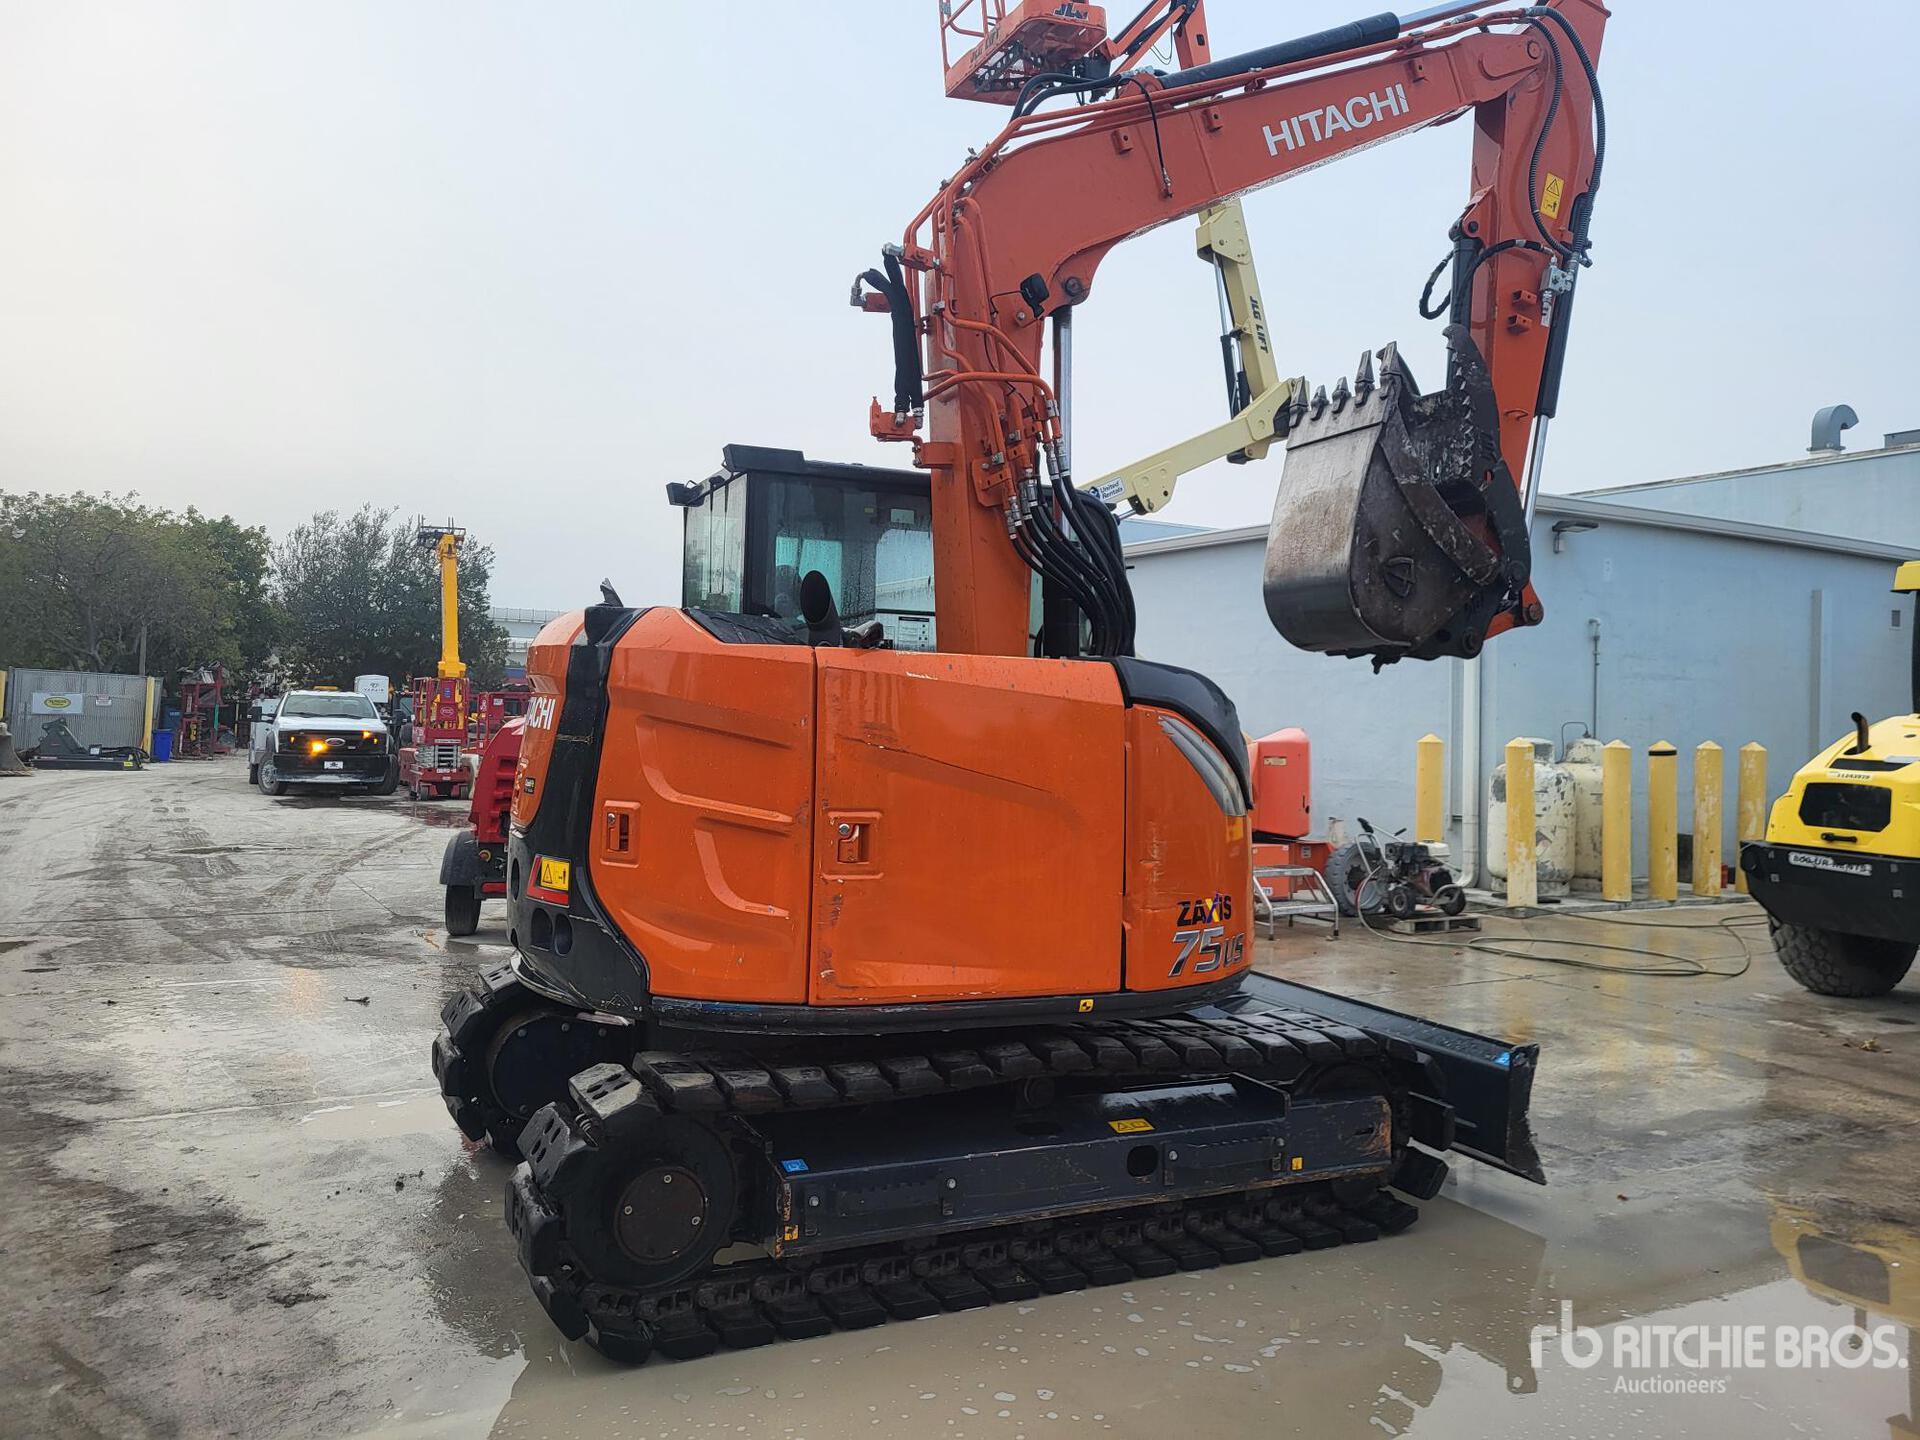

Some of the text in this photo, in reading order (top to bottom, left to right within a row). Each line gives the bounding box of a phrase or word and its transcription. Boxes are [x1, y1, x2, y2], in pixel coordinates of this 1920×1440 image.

[1262, 83, 1410, 157] HITACHI
[1249, 295, 1269, 354] JLG LIFT
[1100, 480, 1120, 493] United
[1102, 486, 1124, 500] Rentals
[1177, 892, 1233, 927] ZAXIS
